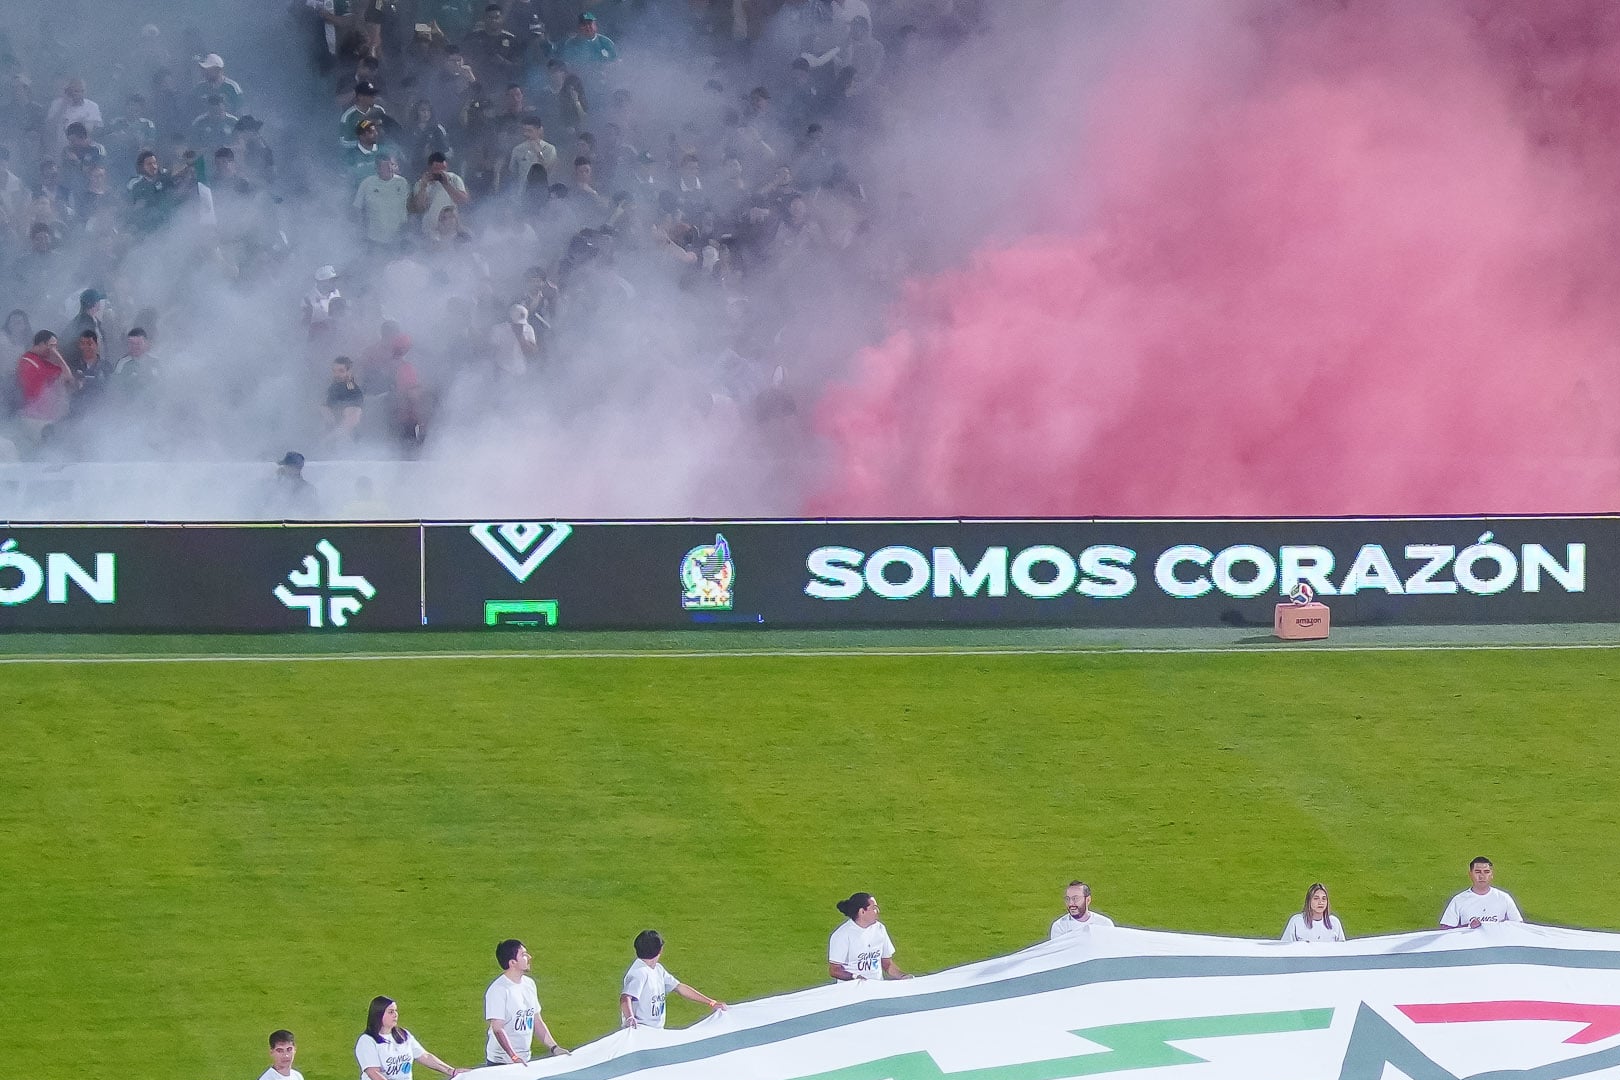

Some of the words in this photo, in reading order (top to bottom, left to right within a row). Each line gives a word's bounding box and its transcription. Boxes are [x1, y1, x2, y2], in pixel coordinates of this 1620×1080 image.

[804, 544, 1137, 600] SOMOS
[1154, 530, 1587, 598] CORAZÓN
[1295, 617, 1322, 625] amazon
